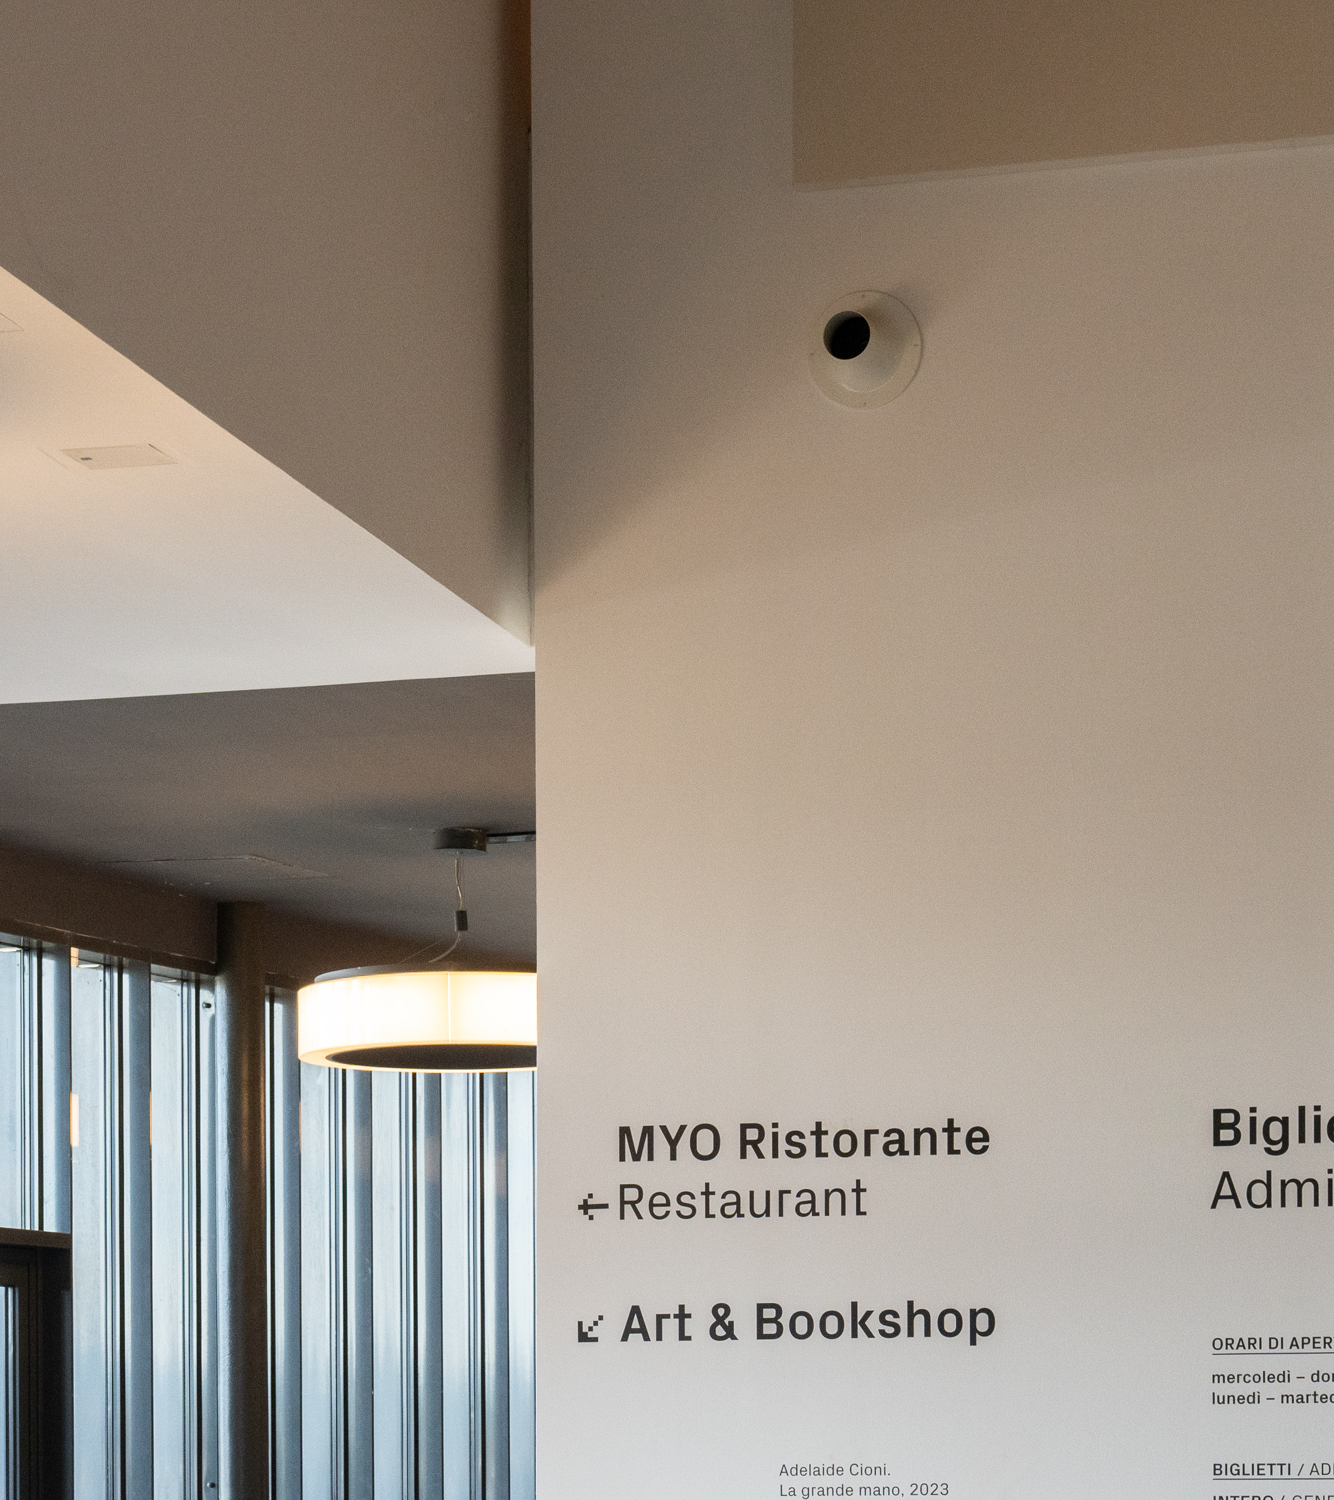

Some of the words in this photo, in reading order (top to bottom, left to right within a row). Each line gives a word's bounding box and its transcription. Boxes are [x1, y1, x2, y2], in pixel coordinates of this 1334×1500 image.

[619, 1123, 720, 1163] MYO
[740, 1117, 989, 1160] Ristorante
[620, 1178, 867, 1221] Restaurant
[621, 1304, 691, 1342] Art
[709, 1302, 738, 1342] &
[757, 1299, 995, 1347] Bookshop
[1212, 1337, 1262, 1351] ORARI
[1269, 1336, 1283, 1350] DI
[1212, 1369, 1290, 1384] mercoledì
[1213, 1391, 1260, 1405] lunedì
[780, 1463, 844, 1477] Adelaide
[850, 1463, 890, 1477] Cioni.
[1213, 1462, 1290, 1477] BIGLIETTI
[1298, 1463, 1304, 1477] /
[781, 1484, 796, 1497] La
[802, 1483, 853, 1500] grande
[860, 1485, 904, 1498] mano,
[910, 1482, 948, 1496] 2023
